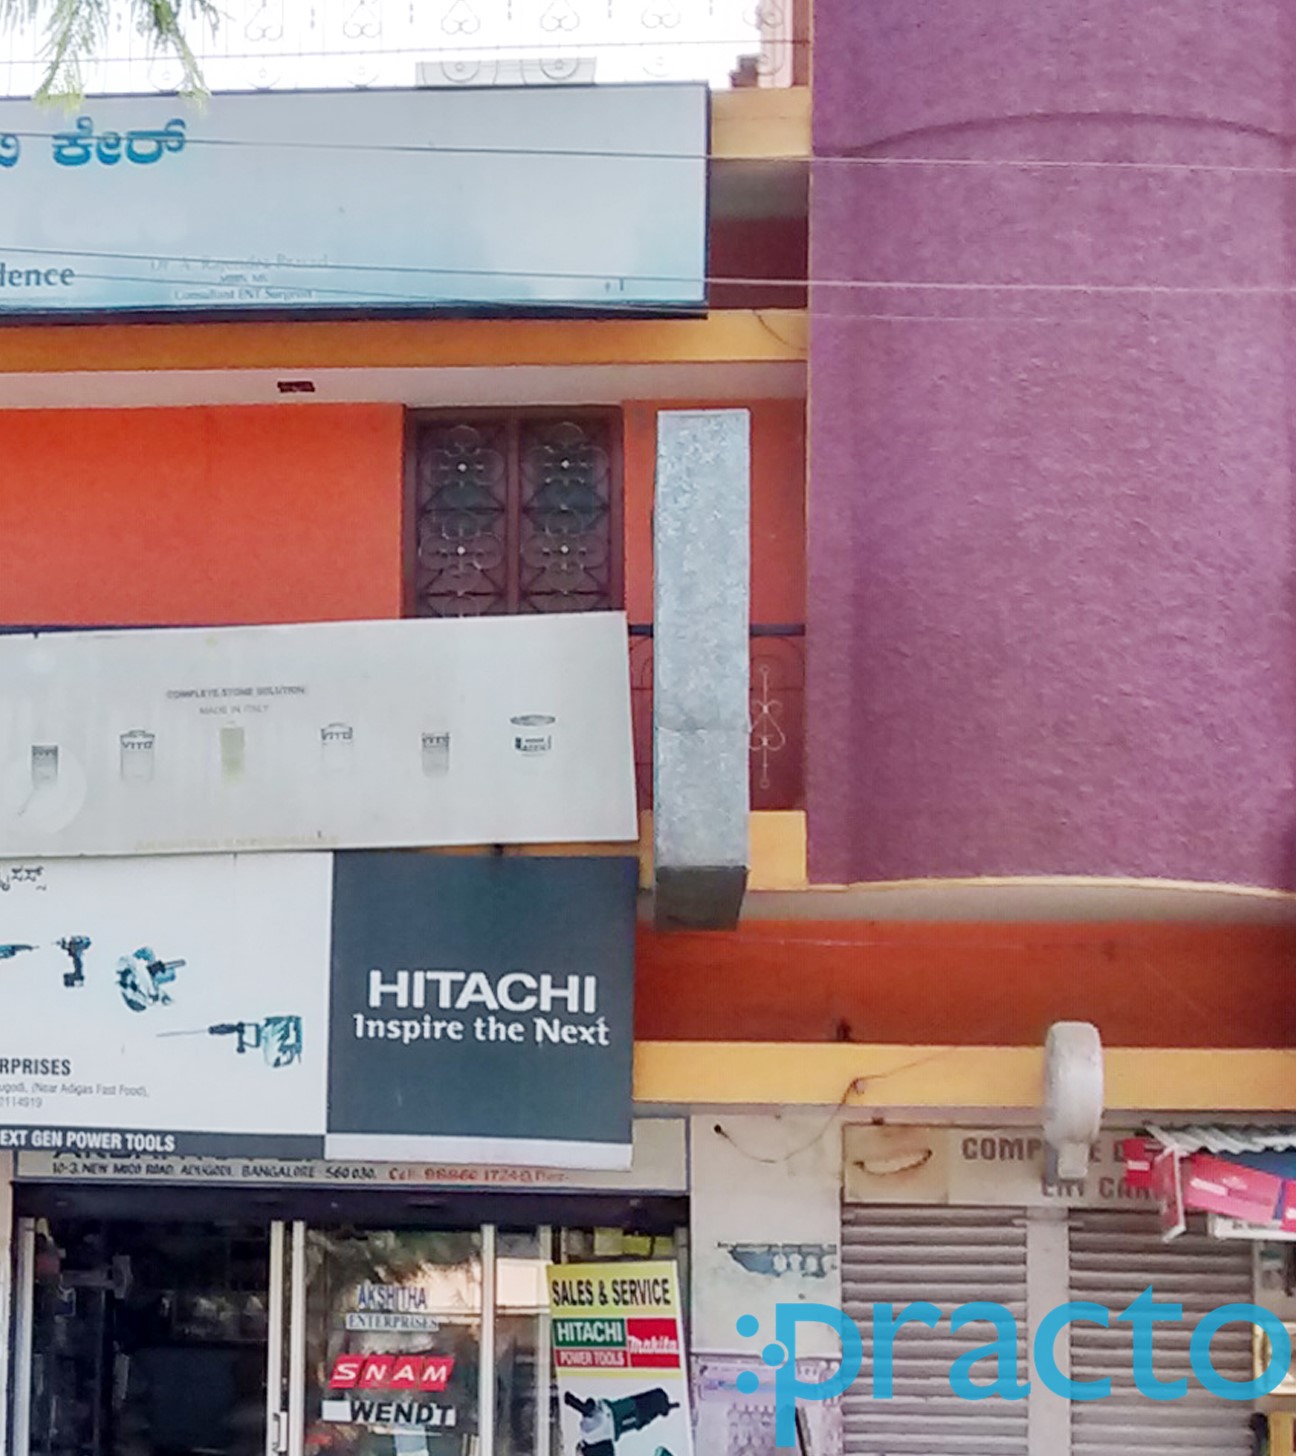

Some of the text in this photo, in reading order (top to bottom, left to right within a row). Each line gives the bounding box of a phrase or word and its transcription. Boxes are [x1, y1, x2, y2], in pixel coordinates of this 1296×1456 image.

[52, 116, 187, 170] ಕೇರ್
[369, 970, 596, 1014] HITACHI
[354, 1014, 610, 1046] Inspire the Next
[31, 1130, 62, 1148] GEN
[66, 1132, 122, 1150] POWER
[124, 1133, 175, 1152] TOOLS
[962, 1136, 1101, 1162] COMPE
[242, 1165, 315, 1178] BANGALORE
[551, 1279, 671, 1306] SALES & SERVICE
[348, 1314, 439, 1330] ENTERPRISES
[557, 1321, 623, 1343] HITACHI
[560, 1350, 625, 1367] POWER TOOLS
[332, 1362, 448, 1384] SNAM
[351, 1401, 454, 1426] WENDT
